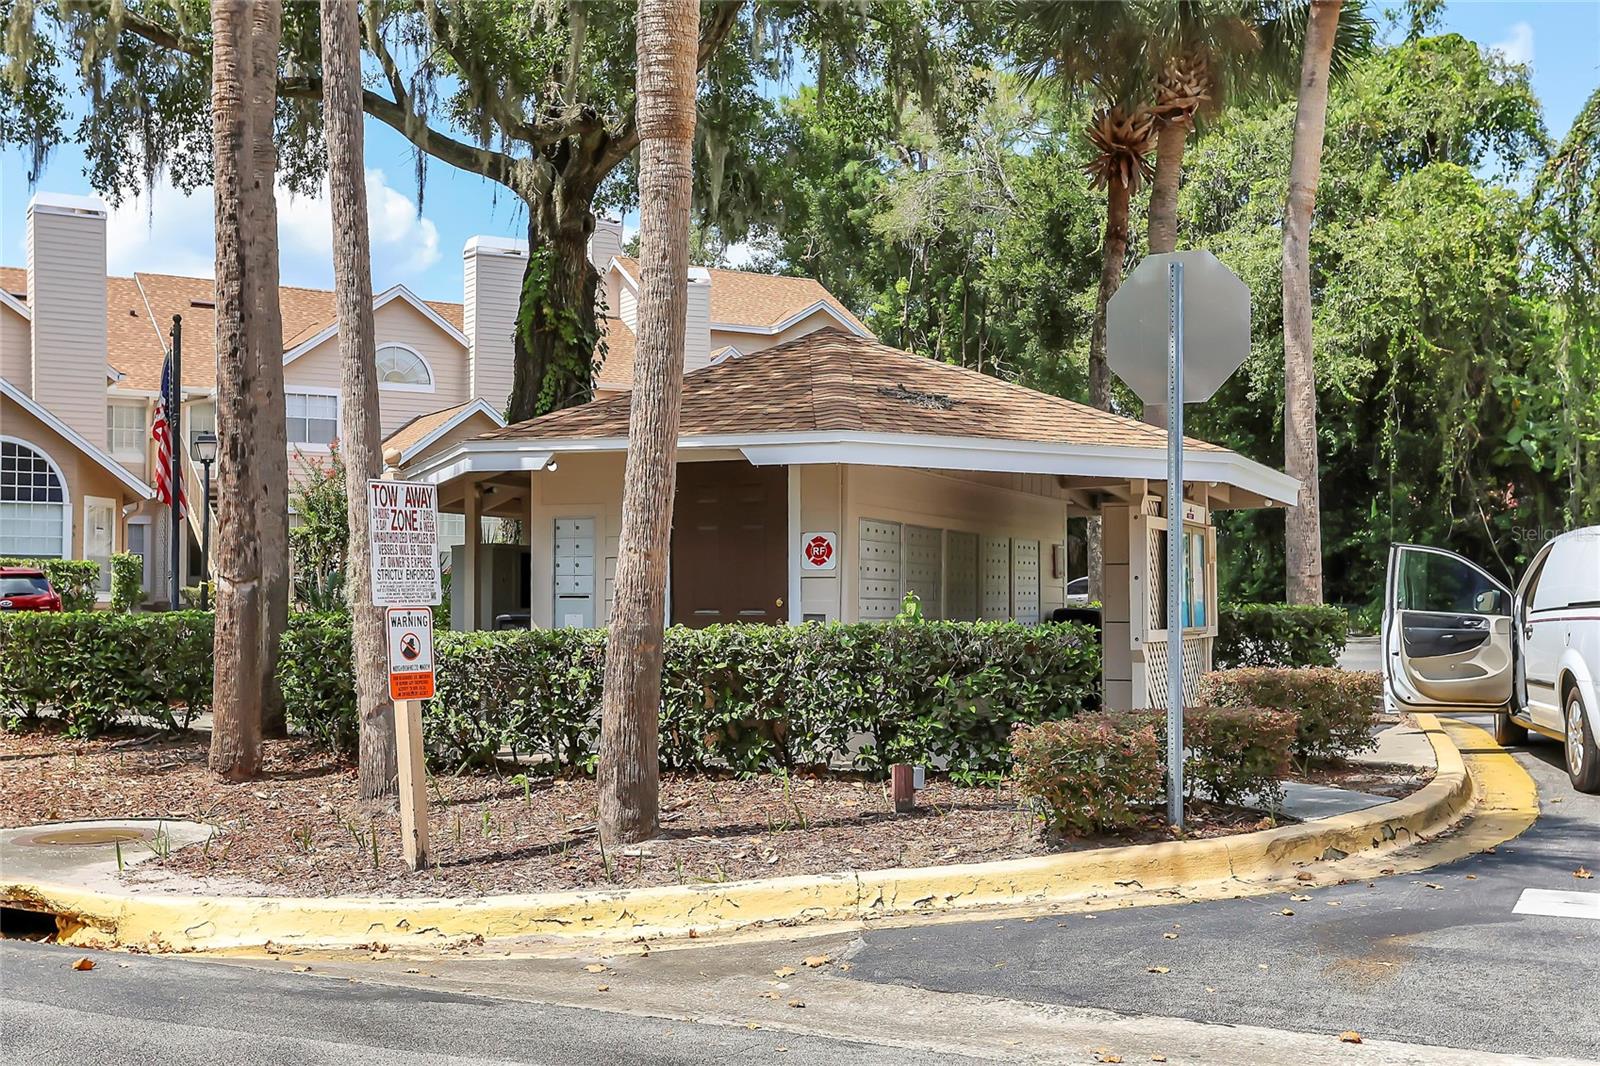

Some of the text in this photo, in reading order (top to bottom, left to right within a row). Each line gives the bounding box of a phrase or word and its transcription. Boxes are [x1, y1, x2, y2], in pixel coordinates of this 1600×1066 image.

[371, 484, 433, 509] TOW AWAY
[391, 509, 418, 532] ZONE
[423, 510, 433, 521] DAYS
[424, 521, 435, 532] WEEK
[373, 532, 435, 544] UNAUTHORIZED VEHICLES OR
[378, 544, 432, 556] VESSELS WILL BE TOWED
[812, 546, 827, 556] RF
[380, 557, 432, 568] AT OWNER'S EXPENSE
[376, 569, 436, 580] STRICTLY ENFORCED
[391, 615, 428, 628] WARNING
